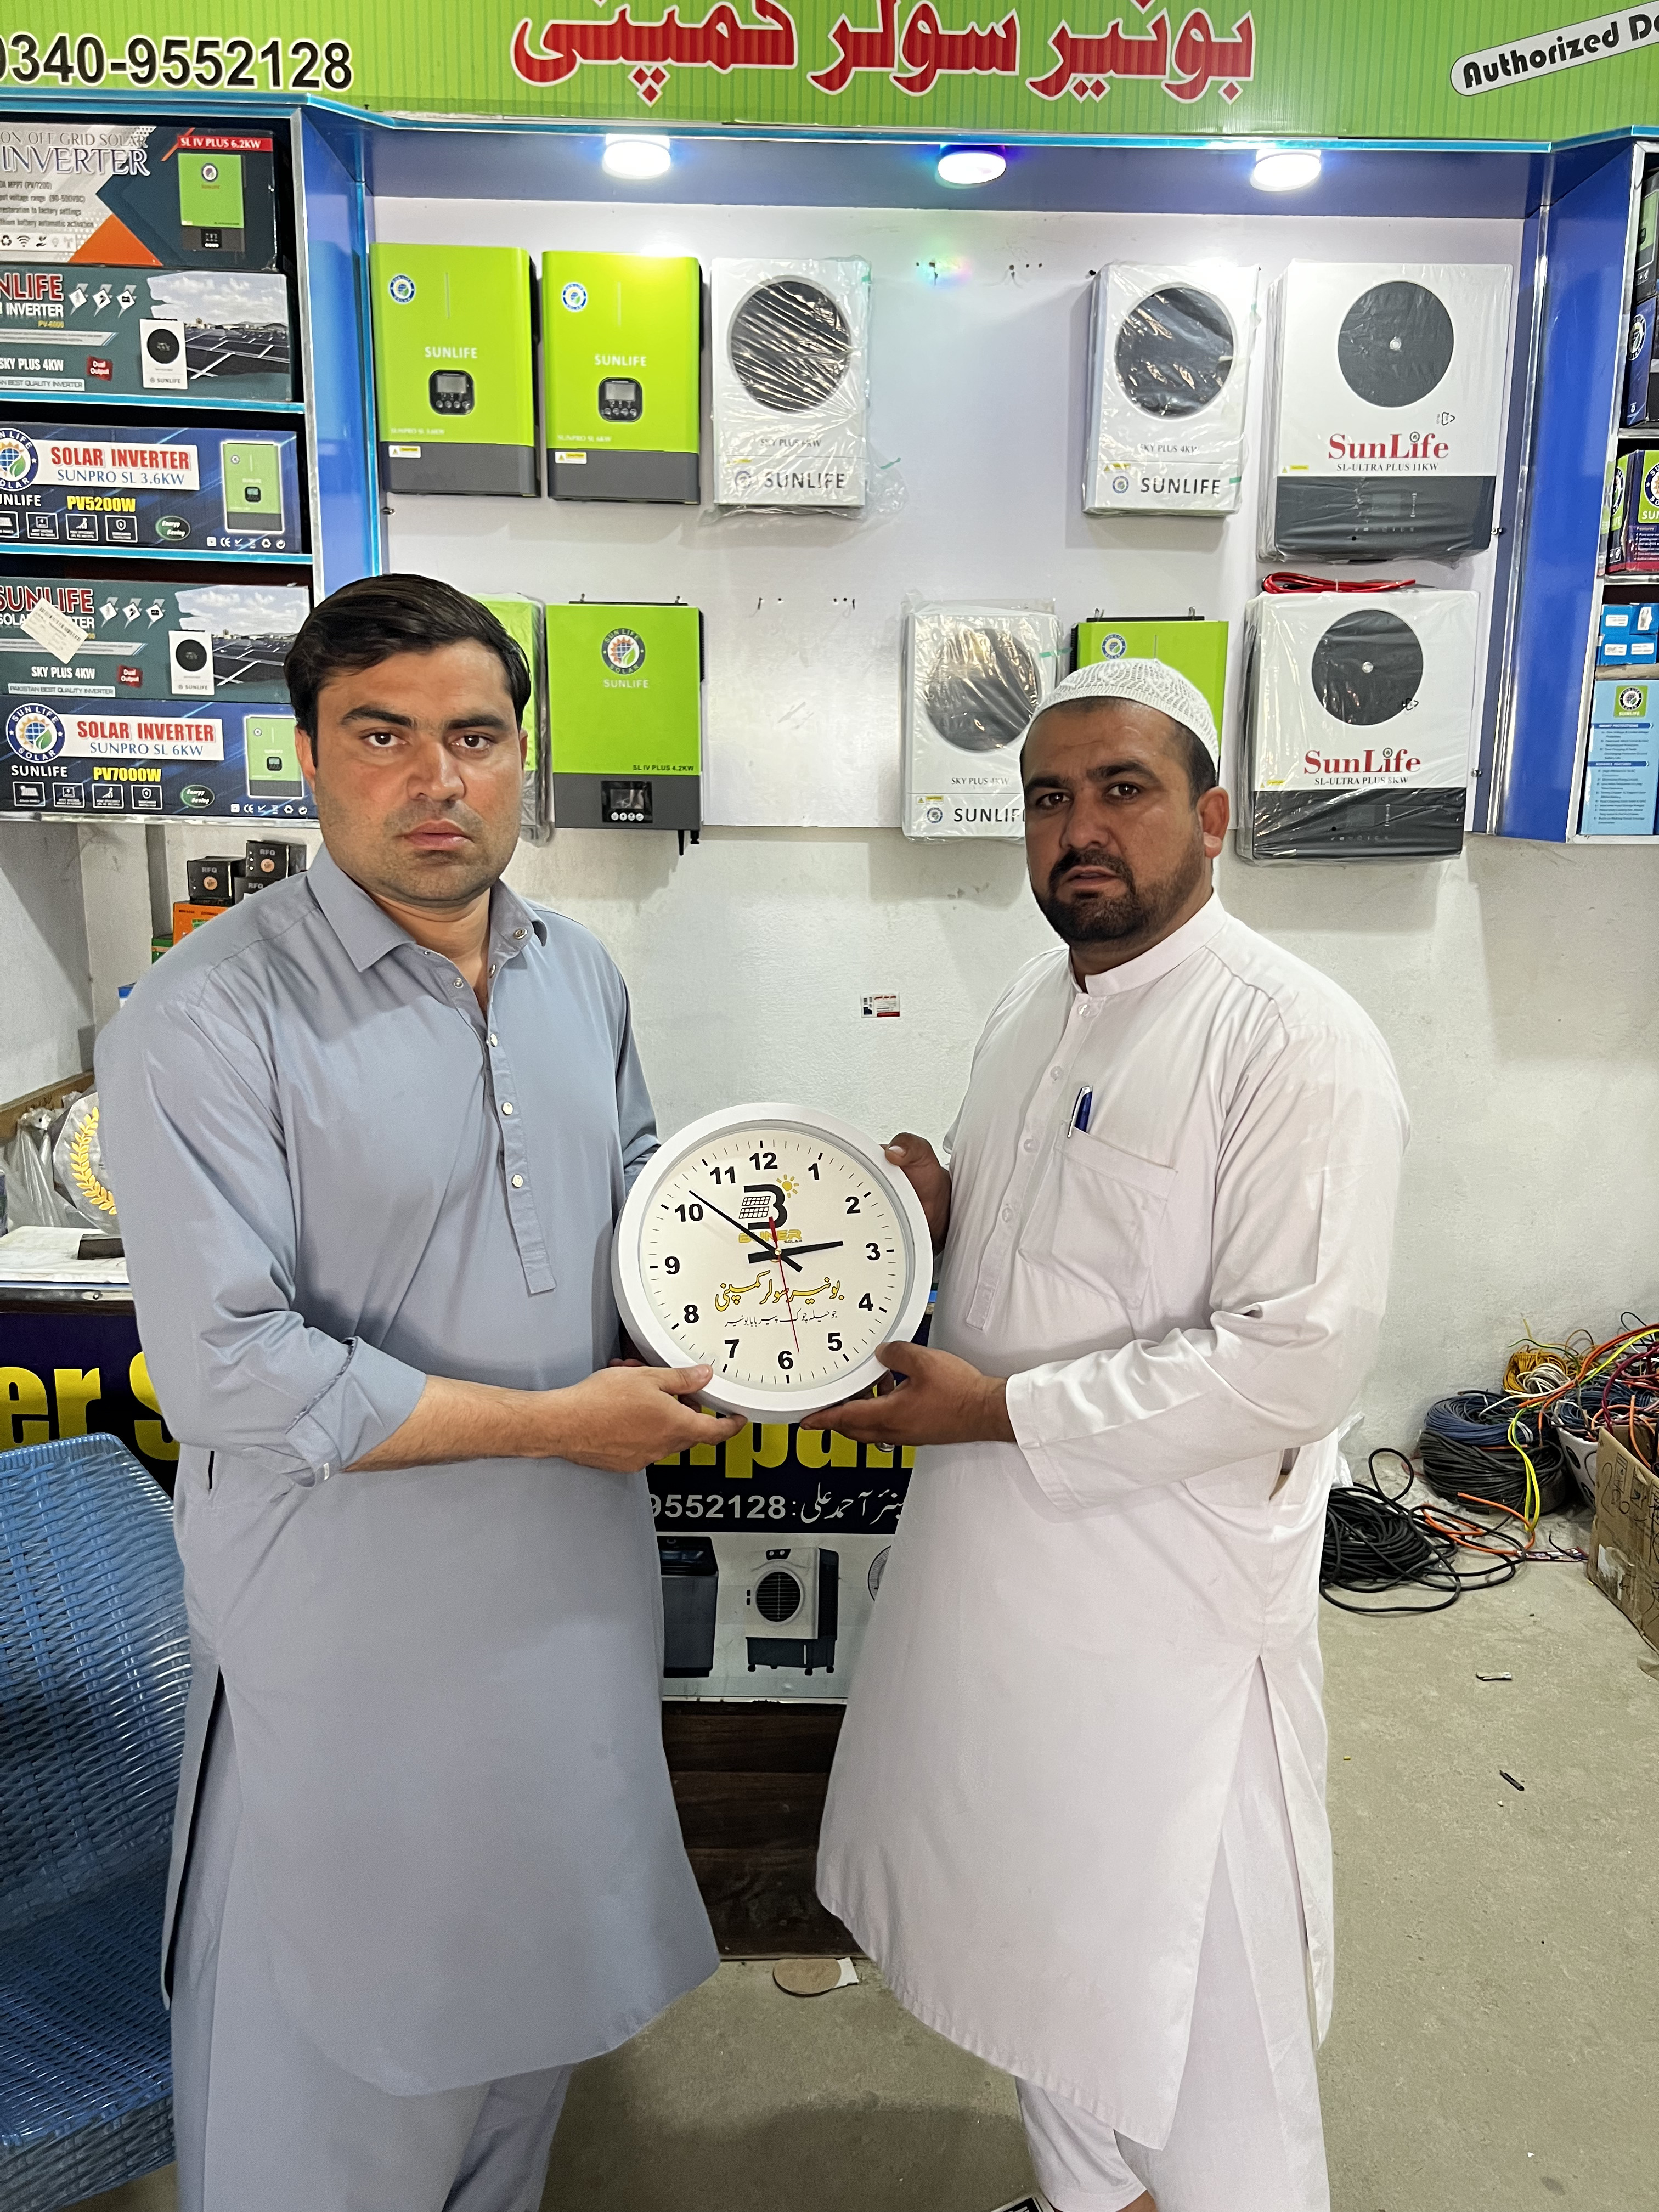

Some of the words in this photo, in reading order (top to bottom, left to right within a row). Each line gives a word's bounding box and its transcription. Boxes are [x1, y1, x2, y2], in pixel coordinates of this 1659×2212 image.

[0, 33, 354, 91] 340-9552128
[1463, 21, 1620, 88] Authorized
[60, 133, 95, 145] GRID
[100, 133, 148, 148] SOLAR
[2, 146, 150, 176] INVERTER
[7, 303, 64, 317] INVERTER
[425, 347, 478, 359] SUNLIFE
[594, 354, 647, 367] SUNLIFE
[18, 359, 41, 370] PLUS
[43, 360, 64, 371] 4KW
[9, 431, 33, 449] LIFE
[761, 439, 776, 447] SY
[1158, 444, 1177, 453] PLUS
[1329, 431, 1449, 459] SunLife
[51, 447, 104, 466] SOLAR
[111, 449, 189, 470] INVERTER
[1337, 463, 1383, 471] SL-ULTRA
[58, 469, 116, 483] SUNPRO
[122, 472, 137, 483] SL
[141, 472, 185, 485] 3.6KW
[764, 471, 845, 489] SUNLIFE
[1141, 478, 1221, 495] SUNLIFE
[0, 494, 42, 506] NLIFE
[67, 495, 136, 512] PV5200W
[605, 629, 619, 643] SUN
[31, 667, 48, 678] SKY
[50, 667, 72, 678] PLUS
[75, 668, 95, 679] 4KW
[610, 664, 640, 674] SOLAR
[603, 679, 649, 689] SUNLIFE
[12, 706, 31, 722] SUN
[36, 706, 59, 724] LIFE
[77, 721, 130, 739] SOLAR
[138, 723, 215, 741] INVERTER
[18, 747, 57, 761] SOLAR
[91, 742, 149, 754] SUNPRO
[154, 744, 168, 755] SL
[173, 744, 204, 756] 6KW
[1304, 747, 1421, 775] SunLife
[11, 765, 68, 778] SUNLIFE
[93, 766, 162, 782] PV7000W
[1314, 777, 1360, 785] SL-ULTRA
[749, 1153, 778, 1170] 12
[710, 1166, 736, 1184] 11
[808, 1163, 820, 1181] 1
[675, 1204, 704, 1222] 10
[845, 1196, 861, 1214] 2
[866, 1242, 881, 1261] 3
[664, 1256, 680, 1274] 9
[715, 1269, 771, 1312] کمپنی
[759, 1279, 789, 1304] سولر
[786, 1277, 845, 1304] بونیر
[858, 1293, 874, 1312] 4
[683, 1304, 699, 1323] 8
[724, 1339, 740, 1358] 7
[827, 1332, 843, 1351] 5
[778, 1350, 794, 1370] 6
[650, 1494, 786, 1519] 9552128
